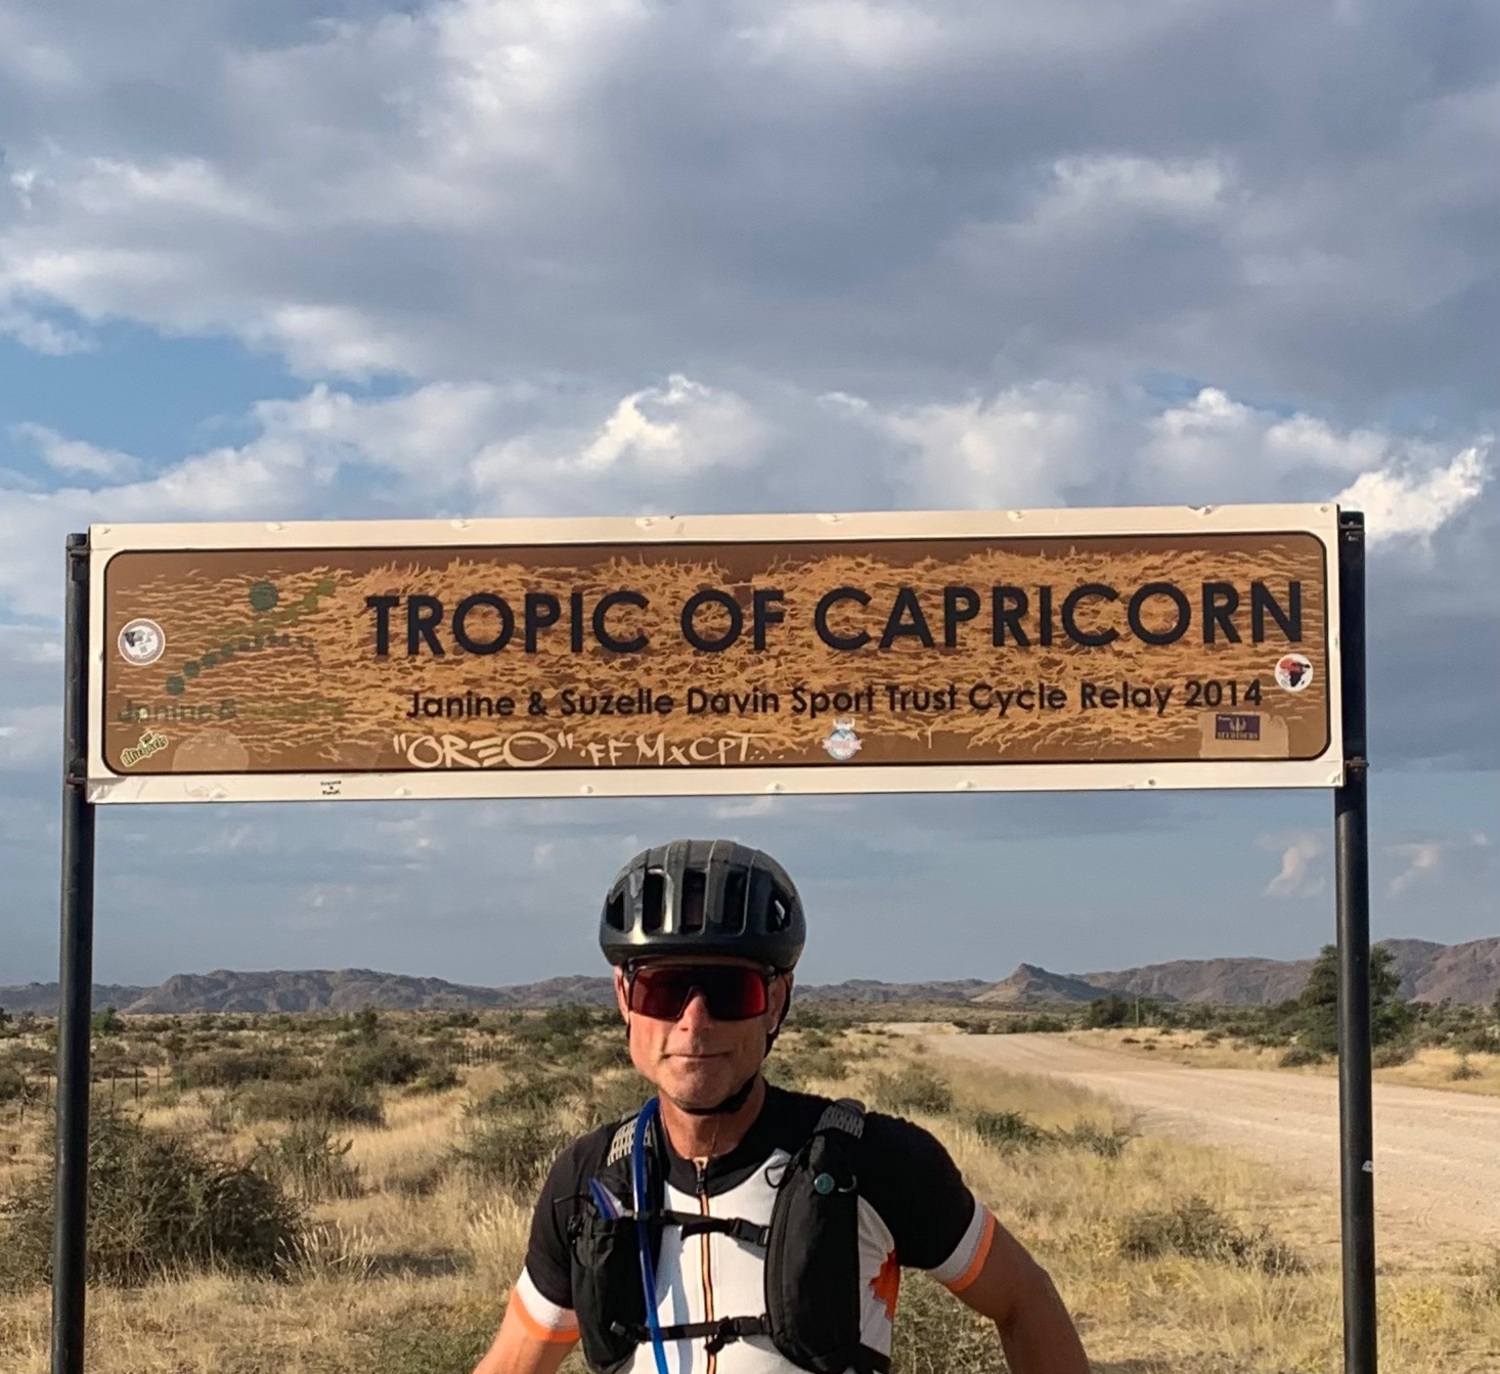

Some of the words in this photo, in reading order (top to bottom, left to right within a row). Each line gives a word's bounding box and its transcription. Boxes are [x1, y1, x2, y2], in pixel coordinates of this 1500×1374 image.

[367, 590, 650, 656] TROPIC
[681, 588, 785, 653] OF
[814, 581, 1302, 650] CAPRICORN
[406, 689, 515, 719] Janine
[527, 690, 548, 717] &
[561, 687, 674, 716] Suzelle
[687, 686, 779, 715] Davin
[791, 682, 875, 718] Sport
[885, 682, 958, 713] Trust
[968, 681, 1068, 717] Cycle
[1080, 680, 1175, 716] Relay
[1184, 678, 1263, 707] 2014
